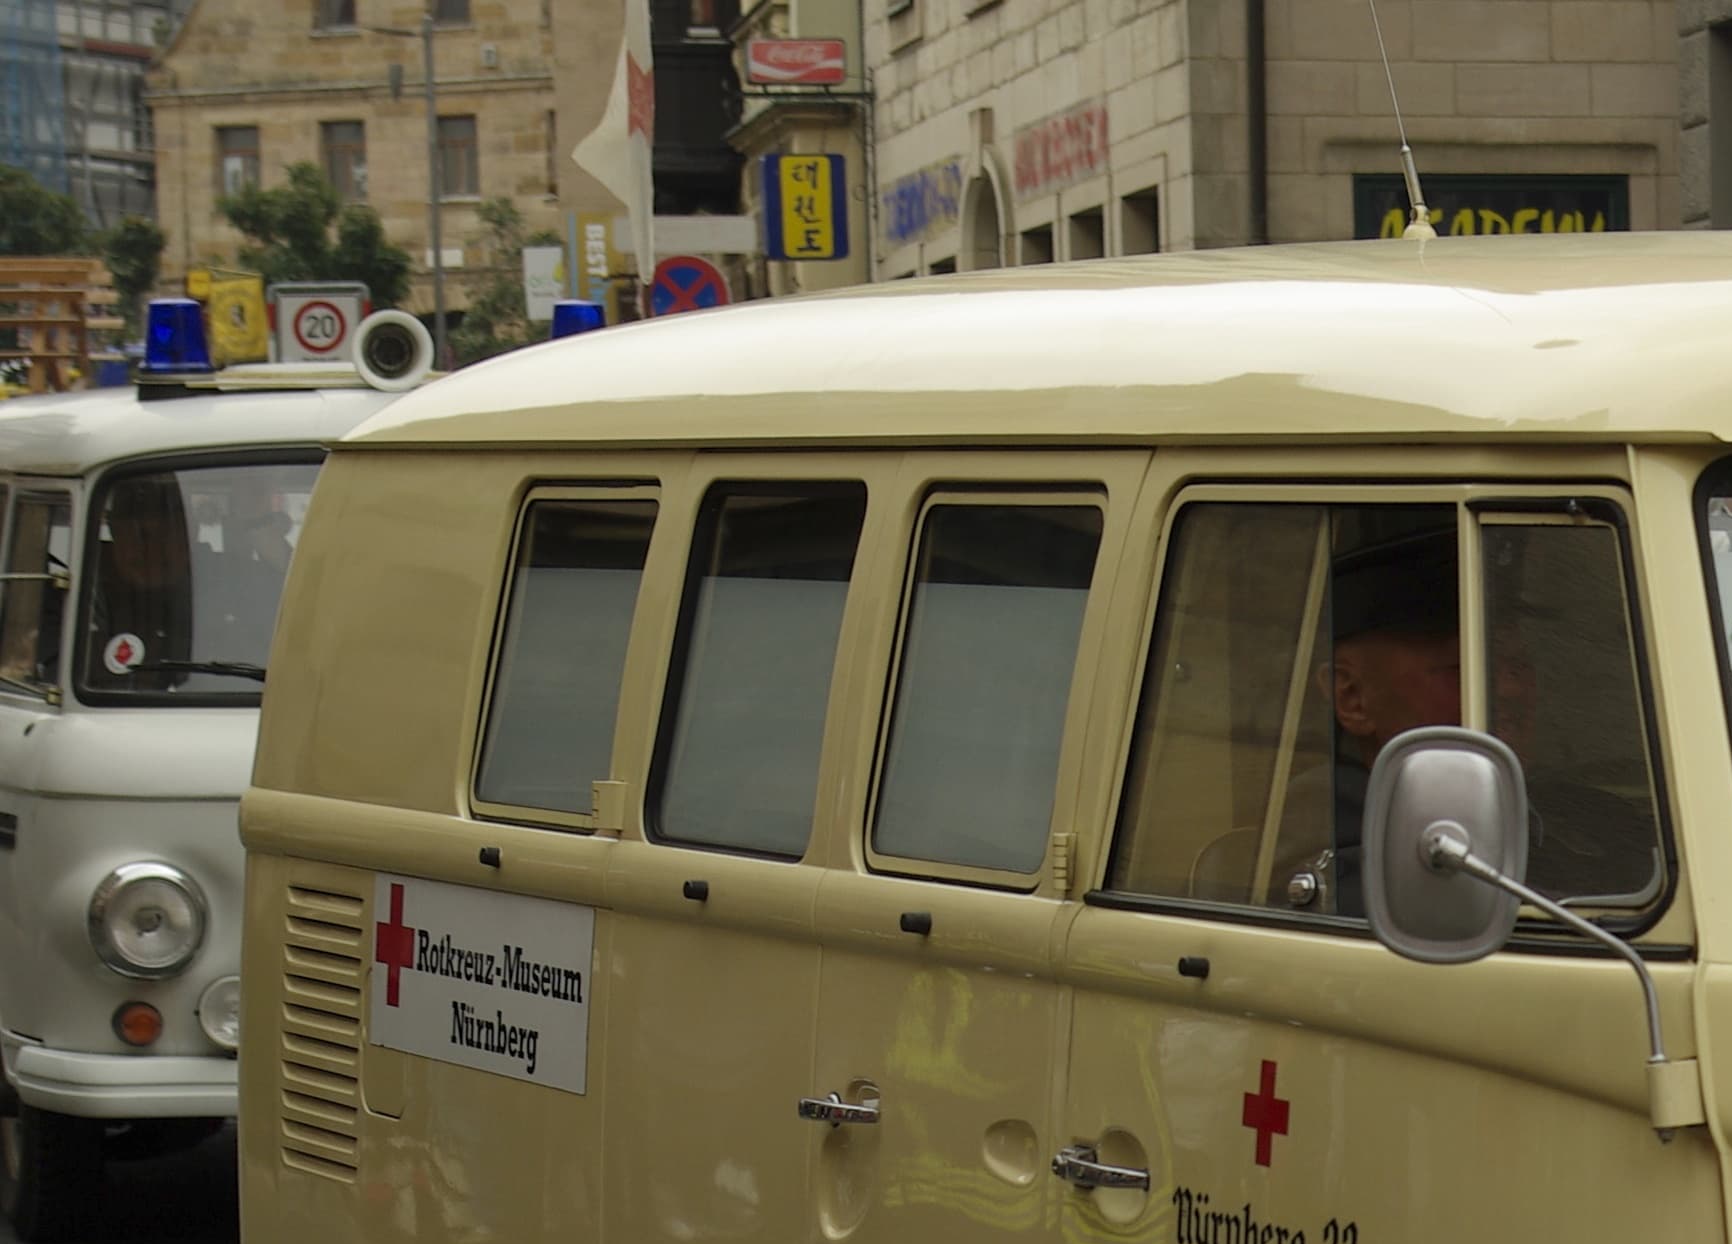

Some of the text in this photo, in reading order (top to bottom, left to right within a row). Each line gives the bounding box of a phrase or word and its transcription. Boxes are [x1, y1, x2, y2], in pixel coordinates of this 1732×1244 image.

[305, 314, 336, 339] 20
[416, 929, 583, 1004] Rotkreuz-Museum
[450, 1000, 539, 1075] Nürnberg
